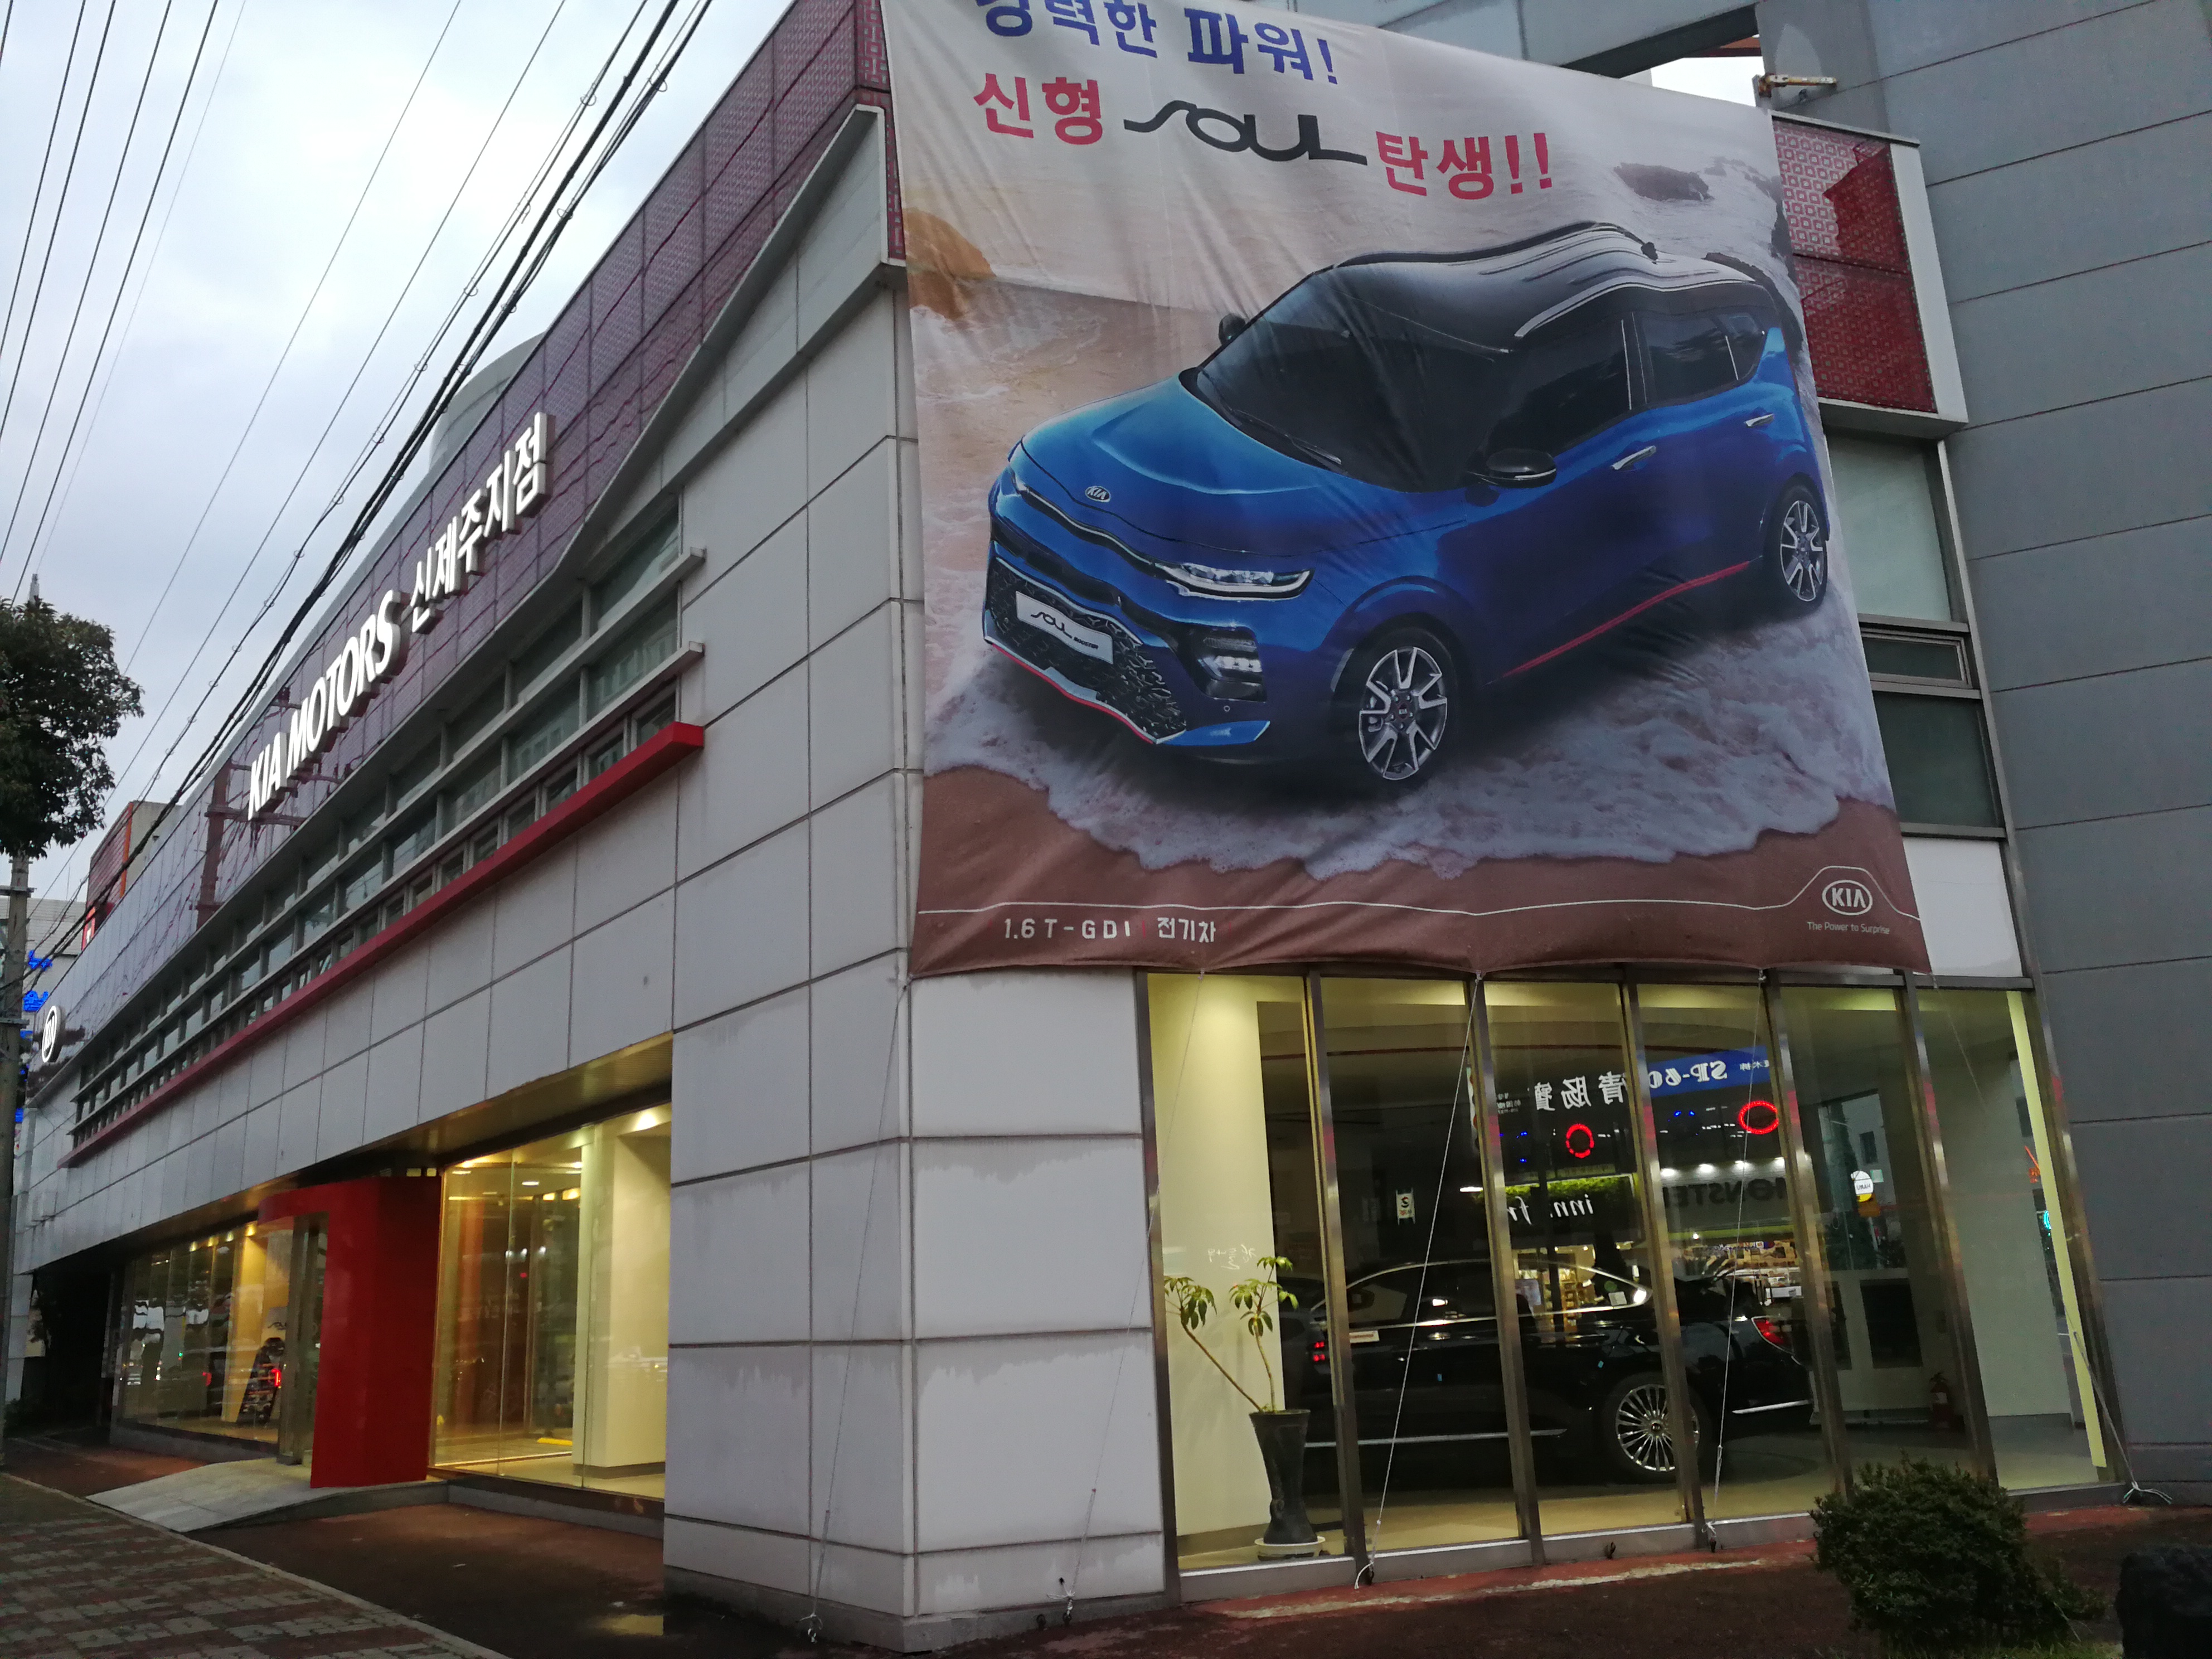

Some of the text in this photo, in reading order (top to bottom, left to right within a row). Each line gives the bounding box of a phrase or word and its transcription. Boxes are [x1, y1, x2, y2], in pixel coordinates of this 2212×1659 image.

[1184, 7, 1338, 85] 파워!
[973, 73, 1103, 145] 신형
[1375, 130, 1553, 201] 탄생!!
[1087, 487, 1107, 499] KIA
[248, 411, 549, 821] KIA MOTORS 신제주지점
[1831, 887, 1866, 909] KIA
[1157, 917, 1217, 943] 전기차
[1807, 921, 1890, 935] The Power to Surprise
